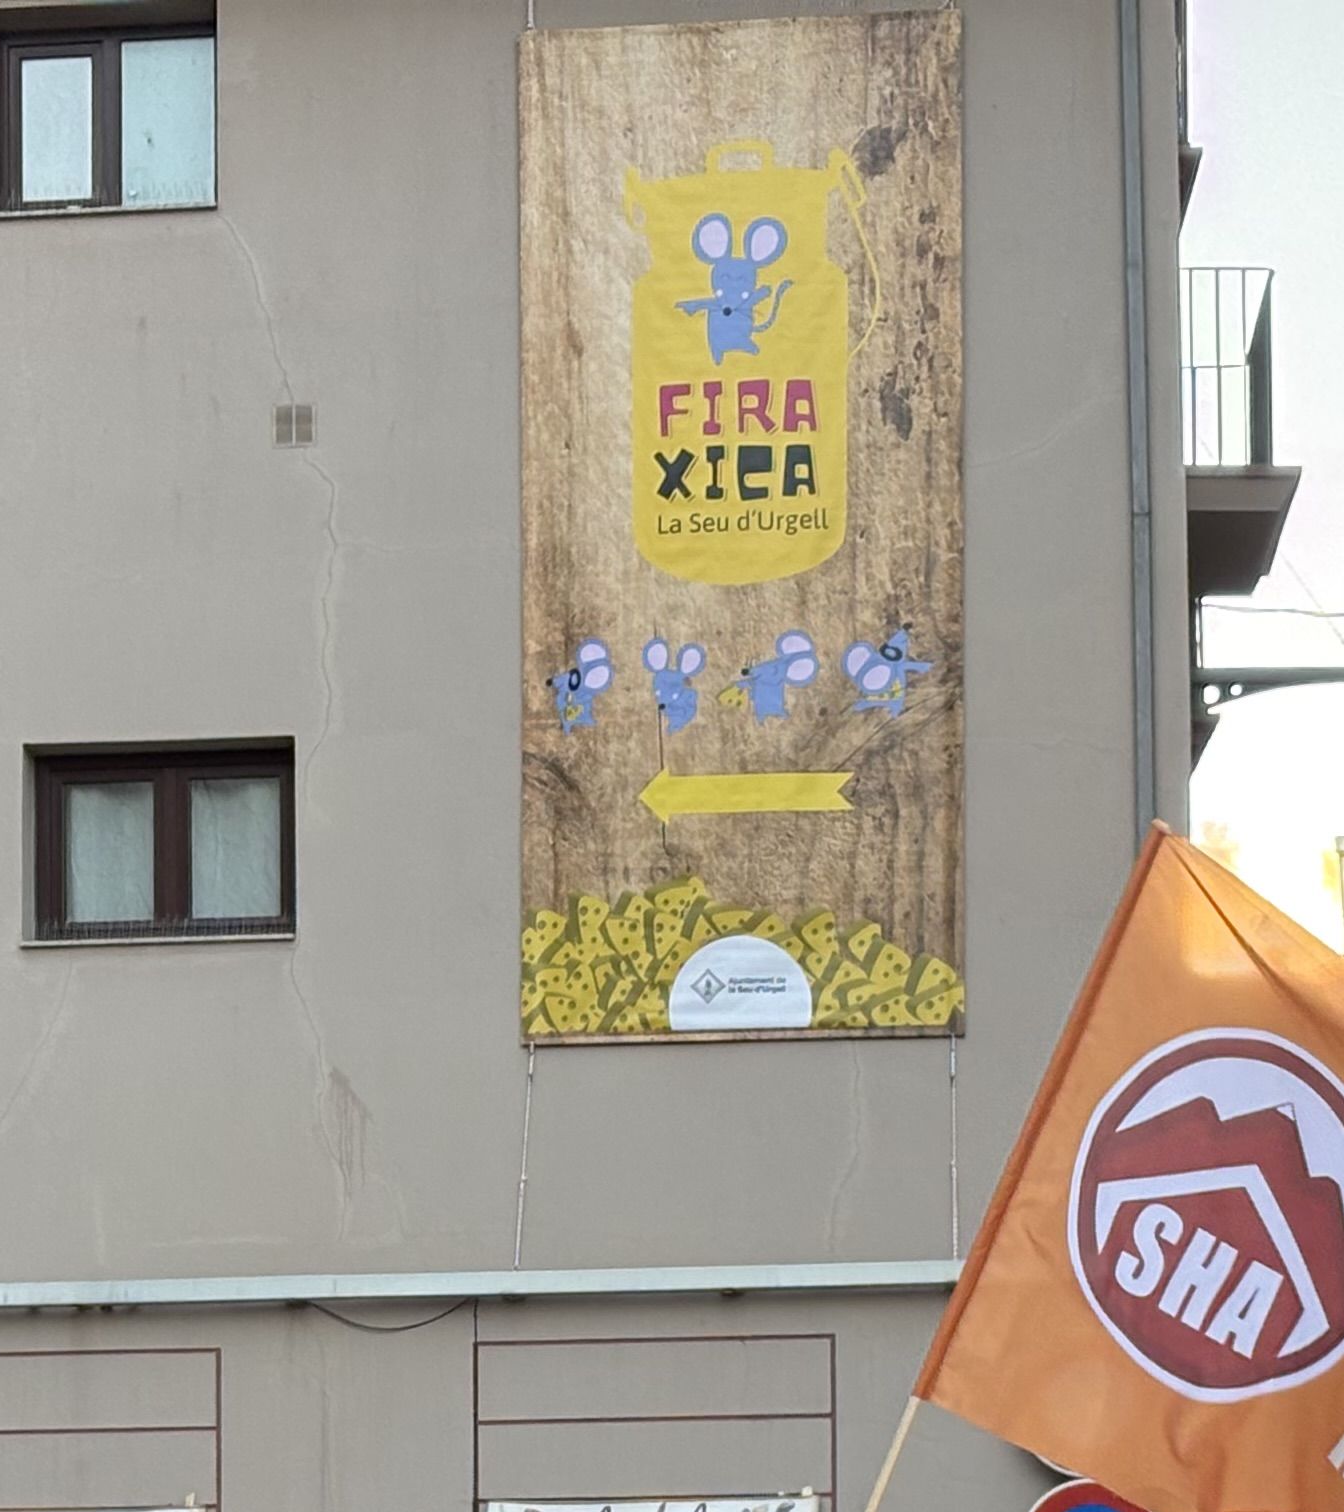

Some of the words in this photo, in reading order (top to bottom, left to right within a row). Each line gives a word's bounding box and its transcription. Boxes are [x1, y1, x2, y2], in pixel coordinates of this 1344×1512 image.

[658, 378, 819, 438] FIRA
[653, 444, 817, 502] XICA
[657, 514, 682, 535] La
[689, 512, 729, 534] Seu
[736, 508, 830, 538] d'Urgell
[1114, 1203, 1284, 1360] SHA
